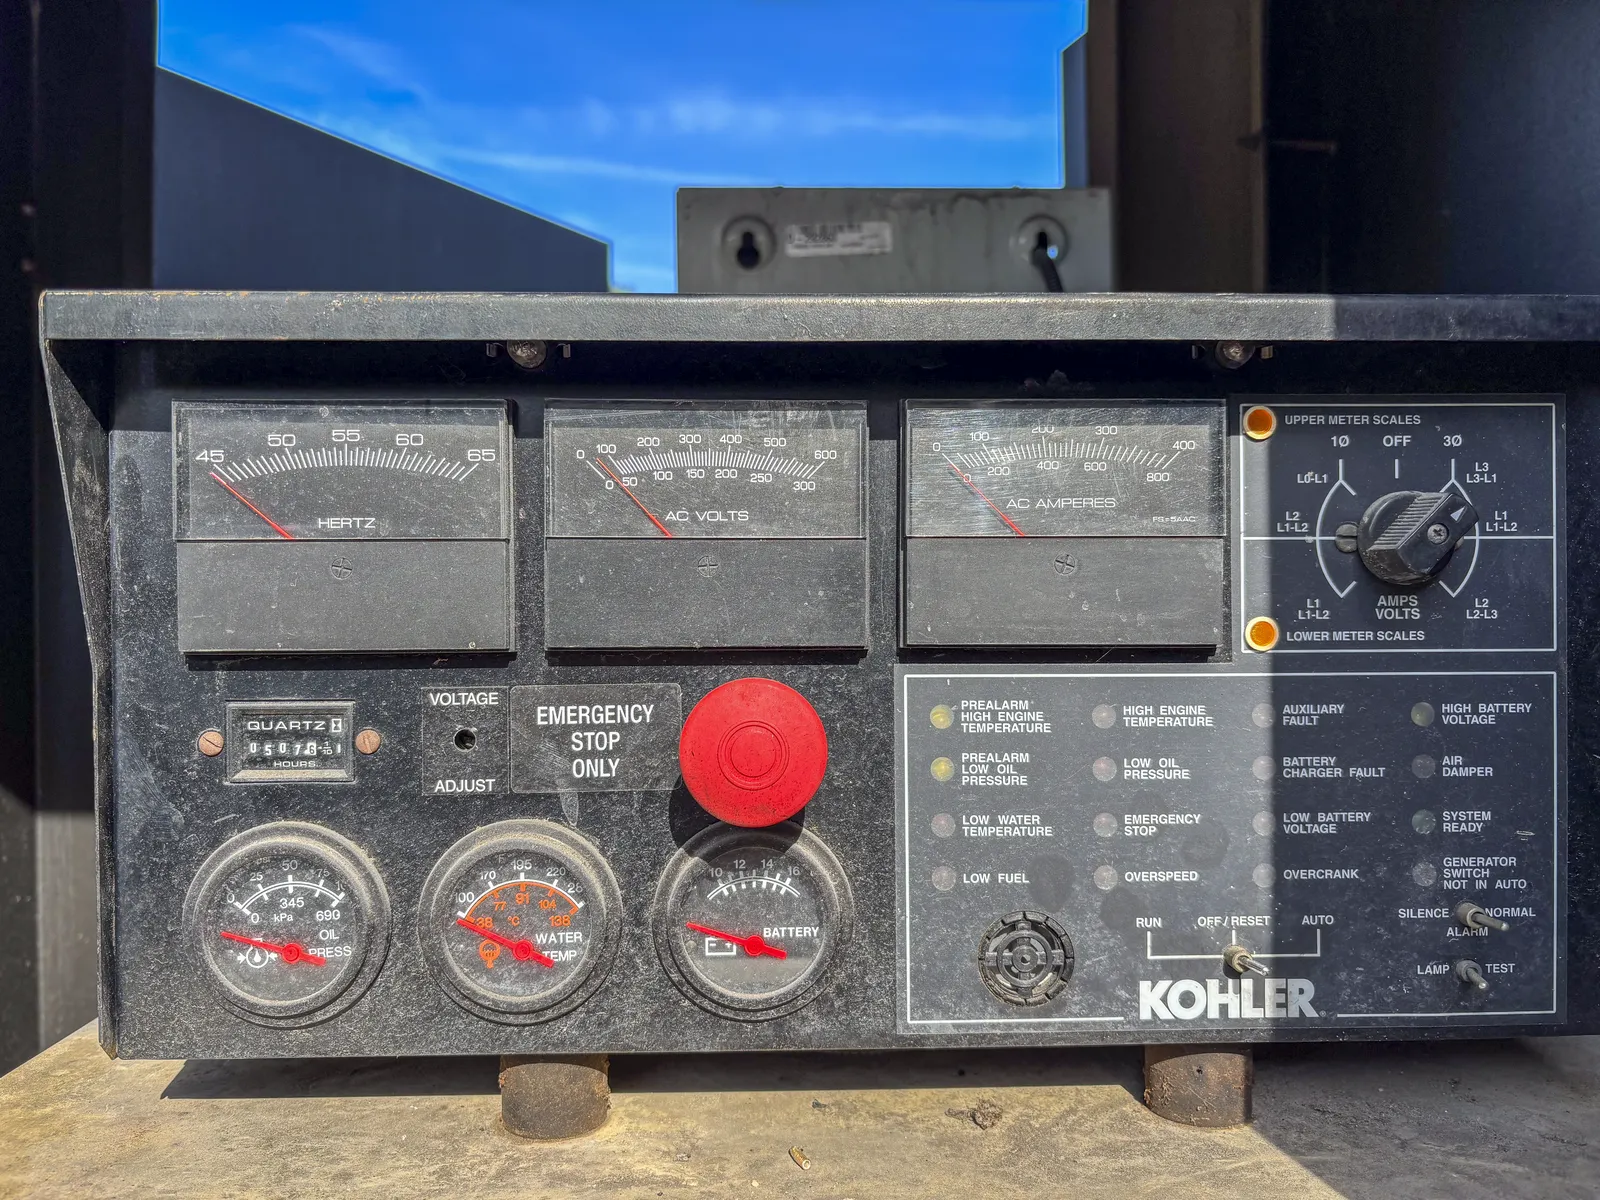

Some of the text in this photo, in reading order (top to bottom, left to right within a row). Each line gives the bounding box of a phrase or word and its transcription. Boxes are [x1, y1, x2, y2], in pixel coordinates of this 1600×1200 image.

[1284, 415, 1421, 425] UPPER METER SCALES
[932, 425, 1195, 452] 0 100 200 300 400
[1383, 435, 1412, 447] OFF
[196, 430, 496, 462] 45 50 55 60 65
[576, 434, 837, 460] 0 100 200 300 400 500 600
[987, 466, 1010, 476] 200
[1037, 460, 1059, 470] 400
[1084, 462, 1107, 471] 600
[1146, 472, 1169, 482] 800
[1475, 462, 1488, 472] L3
[606, 469, 816, 491] 0 50 100 150 200 250 300
[1297, 474, 1328, 484] L0-L1
[1466, 474, 1497, 483] L3-L1
[1006, 498, 1116, 509] AC AMPERES
[665, 511, 749, 521] AC VOLTS
[1286, 511, 1300, 521] L2
[1495, 511, 1507, 520] L1
[318, 518, 376, 529] HERTZ
[1277, 523, 1308, 532] L1-L2
[1486, 522, 1518, 531] L1-L2
[1307, 599, 1319, 608] L1
[1378, 596, 1418, 606] AMPS
[1475, 598, 1489, 608] L2
[1298, 610, 1329, 620] L1-L2
[1375, 609, 1420, 620] VOLTS
[1466, 610, 1498, 619] L2-L3
[1287, 631, 1425, 642] LOWER METER SCALES
[430, 693, 498, 706] VOLTAGE
[961, 701, 1029, 710] PREALARM
[1123, 705, 1206, 716] HIGH ENGINE
[1283, 704, 1344, 714] AUXILIARY
[1442, 703, 1532, 713] HIGH BATTERY
[537, 704, 654, 725] EMERGENCY
[961, 712, 1044, 722] HIGH ENGINE
[1123, 717, 1213, 727] TEMPERATURE
[1283, 716, 1319, 726] FAULT
[1442, 715, 1496, 725] VOLTAGE
[248, 721, 326, 730] QUARTZ
[961, 723, 1051, 733] TEMPERATURE
[571, 732, 621, 751] STOP
[961, 753, 1030, 763] PREALARM
[1124, 758, 1179, 768] LOW OIL
[1283, 757, 1336, 767] BATTERY
[1442, 756, 1462, 766] AIR
[572, 758, 620, 778] ONLY
[962, 765, 1017, 774] LOW OIL
[1283, 767, 1386, 778] CHARGER FAULT
[1442, 767, 1493, 777] DAMPER
[1124, 769, 1190, 780] PRESSURE
[434, 779, 495, 792] ADJUST
[962, 776, 1028, 786] PRESSURE
[962, 815, 1040, 825] LOW WATER
[1124, 814, 1201, 825] EMERGENCY
[1283, 812, 1371, 823] LOW BATTERY
[1442, 811, 1491, 821] SYSTEM
[962, 826, 1053, 836] TEMPERATURE
[1125, 826, 1156, 836] STOP
[1283, 824, 1337, 834] VOLTAGE
[1443, 823, 1483, 833] READY
[1443, 857, 1516, 867] GENERATOR
[250, 872, 263, 881] 25
[282, 860, 298, 870] 50
[318, 869, 330, 877] 75
[709, 859, 800, 877] 10 12 14 16
[963, 873, 1030, 883] LOW FUEL
[1125, 871, 1199, 882] OVERSPEED
[1283, 869, 1359, 879] OVERCRANK
[1443, 869, 1490, 878] SWITCH
[456, 860, 583, 903] 100 170 195 220 28
[1444, 880, 1527, 890] NOT IN AUTO
[251, 897, 340, 923] 0 345 690
[476, 893, 571, 928] 38 77 91 104 138
[1398, 908, 1449, 918] SILENCE
[1485, 907, 1536, 918] NORMAL
[274, 913, 293, 922] kPa
[1136, 917, 1162, 928] RUN
[1301, 915, 1334, 926] AUTO
[320, 929, 339, 940] OIL
[763, 926, 819, 938] BATTERY
[1446, 927, 1488, 937] ALARM
[535, 932, 582, 944] WATER
[308, 946, 352, 958] PRESS
[542, 951, 577, 962] TEMP
[1417, 963, 1515, 974] LAMP TEST
[1139, 978, 1320, 1020] KOHLER
